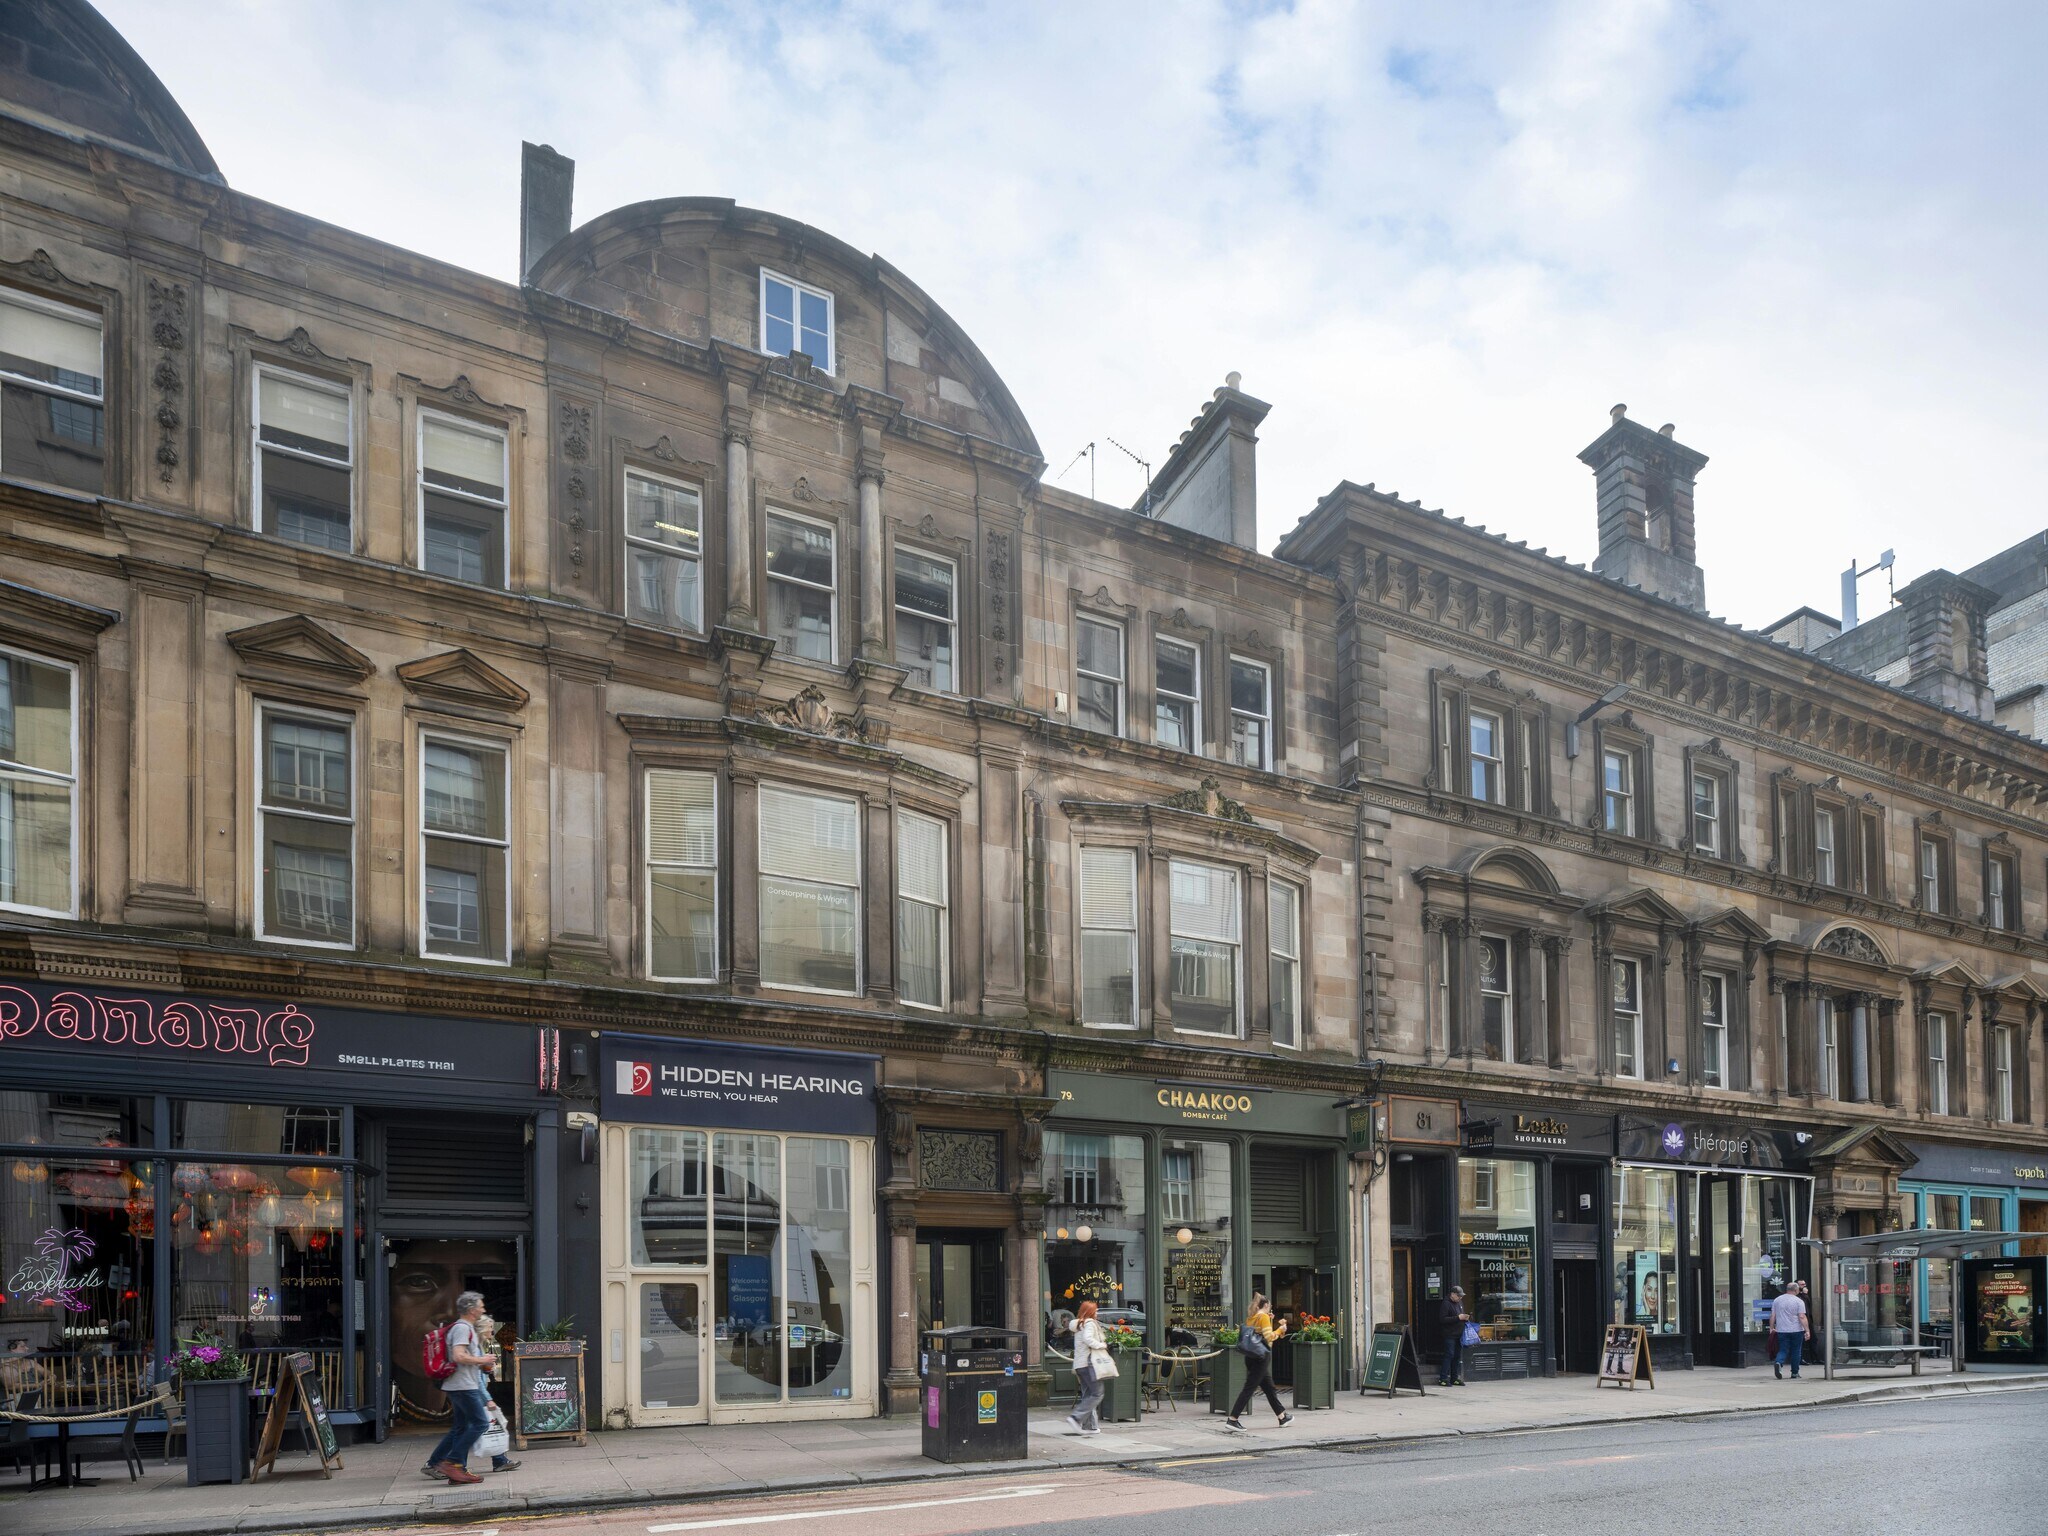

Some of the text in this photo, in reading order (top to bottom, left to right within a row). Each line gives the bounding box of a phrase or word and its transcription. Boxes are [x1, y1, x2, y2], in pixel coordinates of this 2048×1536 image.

[767, 886, 848, 905] Corstorphine & Wright
[661, 1065, 863, 1096] HIDDEN HEARING
[661, 1088, 778, 1104] WE LISTEN, YOU HEAR
[1060, 1091, 1075, 1101] 79.
[1157, 1088, 1252, 1114] CHAAKOO
[1182, 1111, 1228, 1121] BOMBAY CAFÉ
[1417, 1112, 1432, 1129] 81
[1514, 1114, 1568, 1135] Loake
[1469, 1134, 1493, 1144] Loake
[1515, 1135, 1567, 1145] SHOEMAKERS
[1694, 1129, 1748, 1157] thérapie
[1480, 1260, 1516, 1272] Loake
[8, 1267, 104, 1293] Cocktails
[1074, 1270, 1117, 1291] CHAAKOO
[733, 1294, 767, 1303] Glasgow
[533, 1380, 567, 1392] Street
